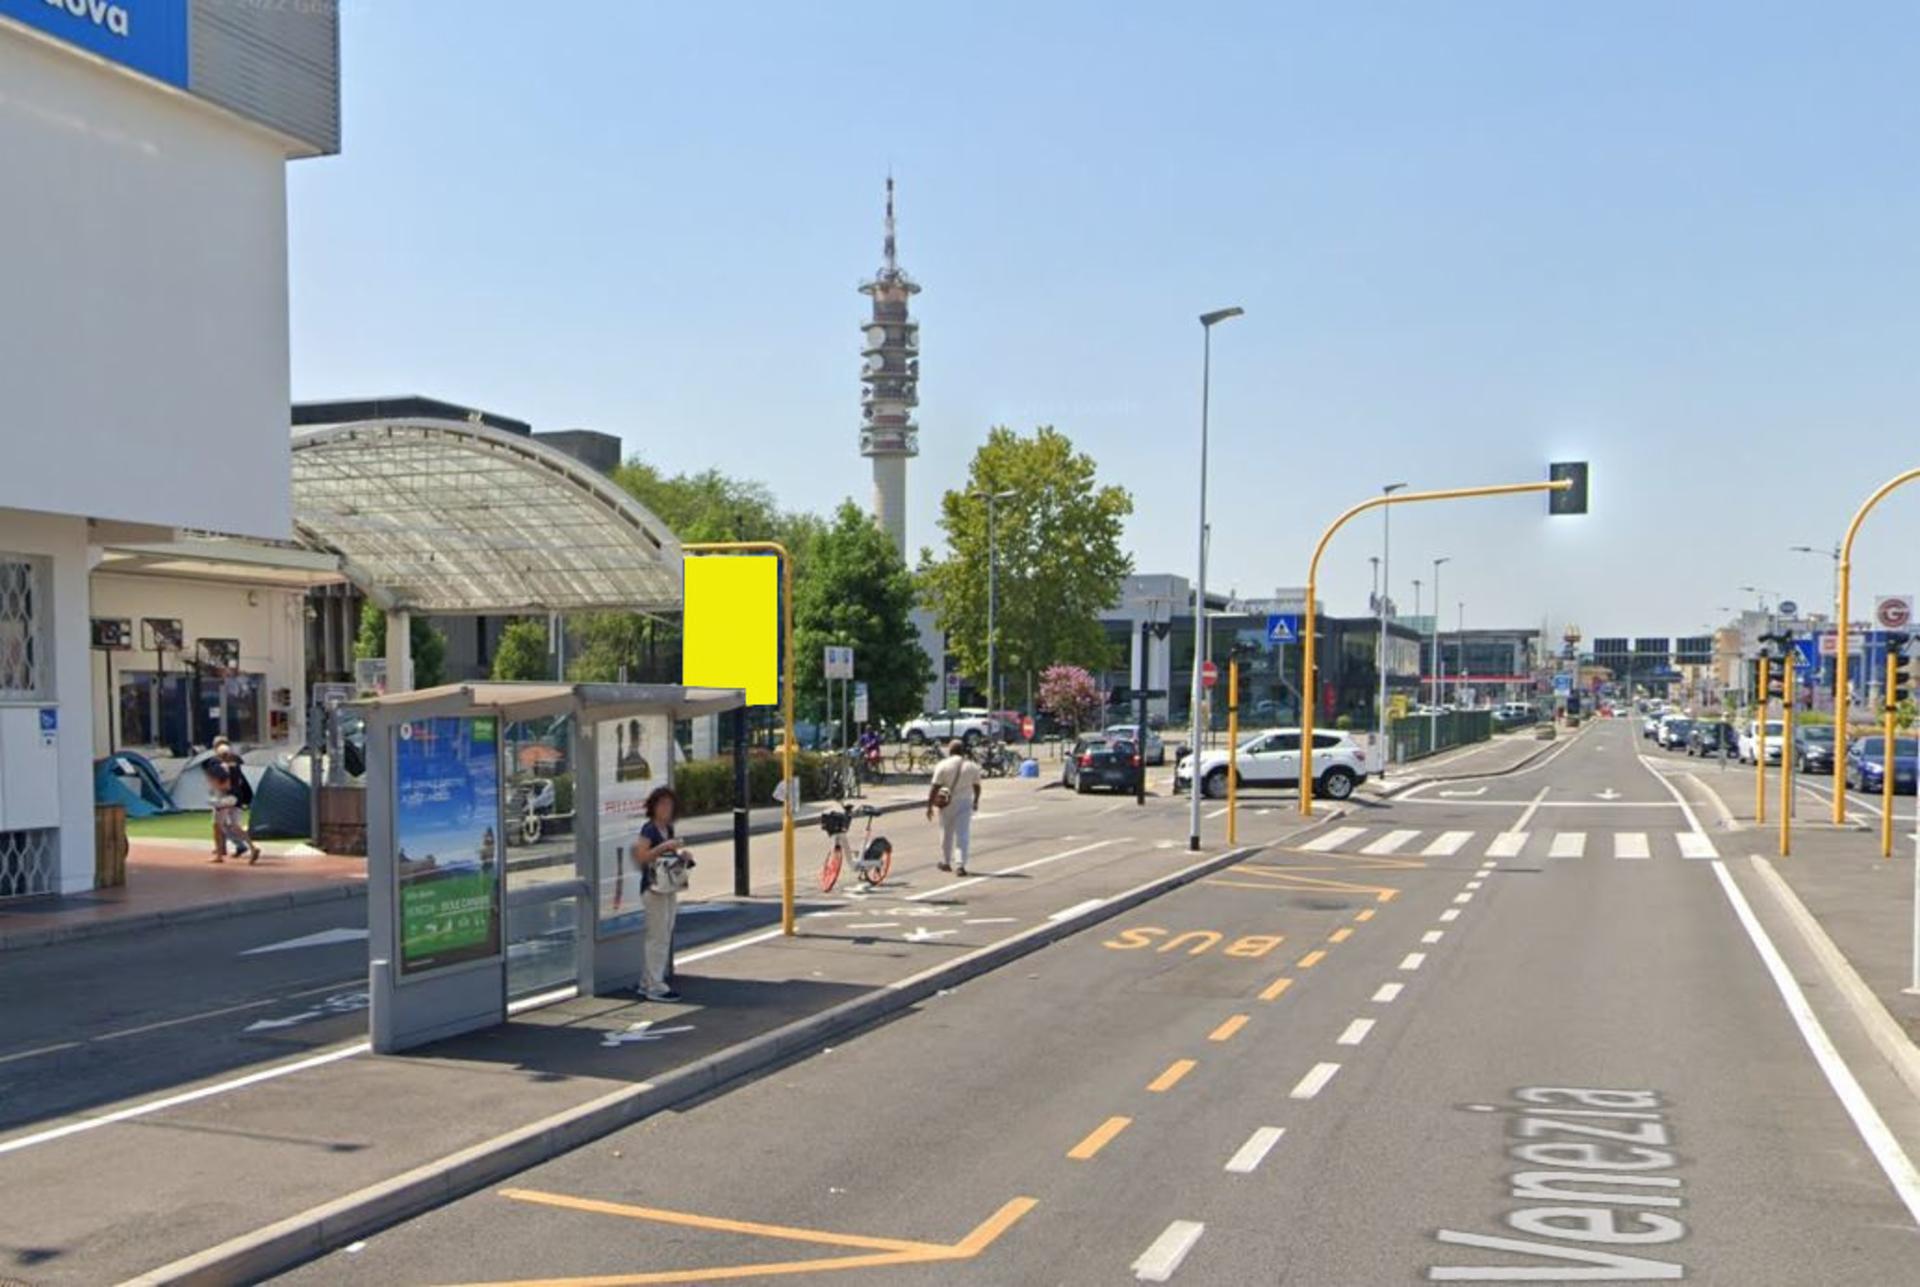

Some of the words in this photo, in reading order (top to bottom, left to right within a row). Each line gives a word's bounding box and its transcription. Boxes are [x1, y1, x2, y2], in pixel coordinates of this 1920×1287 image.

[44, 0, 129, 37] ova
[1102, 926, 1287, 957] BUS
[1428, 1086, 1685, 1281] Venezia
